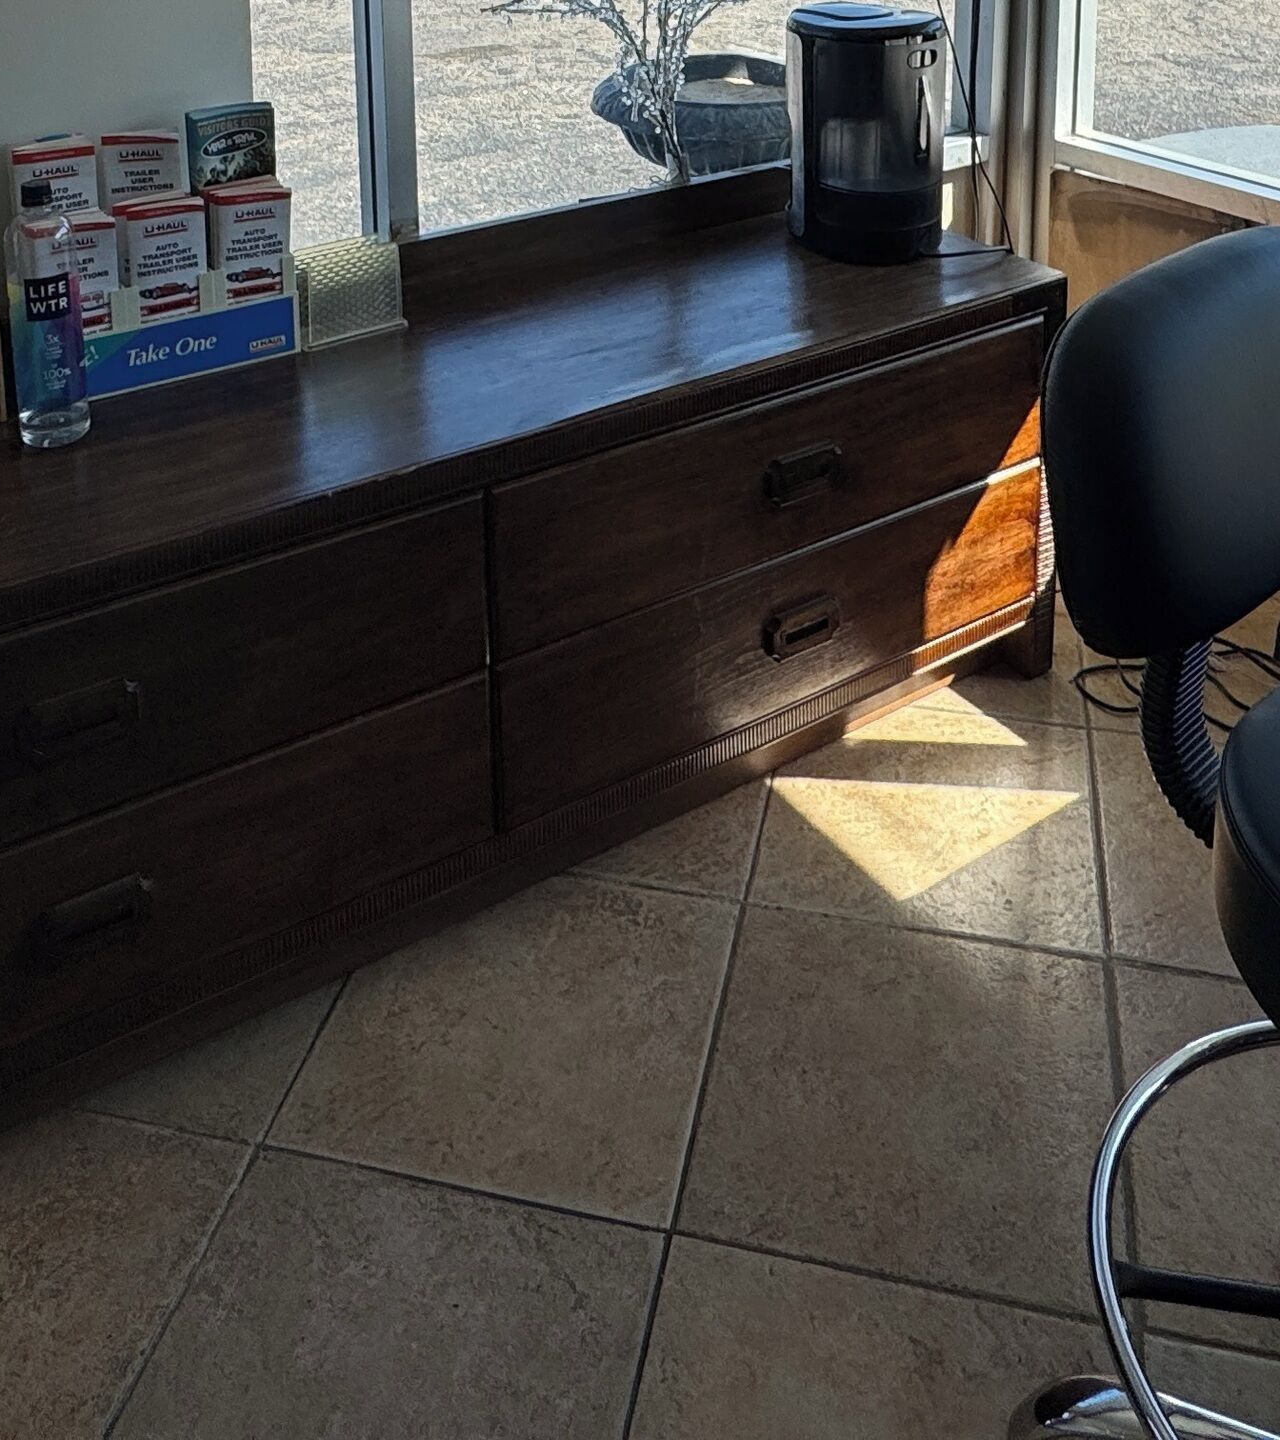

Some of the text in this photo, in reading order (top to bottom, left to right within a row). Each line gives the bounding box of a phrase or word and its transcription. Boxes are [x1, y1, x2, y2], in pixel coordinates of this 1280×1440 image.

[119, 149, 161, 158] U-HAUL
[32, 165, 78, 178] U-HAUL
[124, 169, 160, 177] TRAILER
[131, 177, 154, 185] USER
[111, 183, 174, 194] INSTRUCTIONS
[65, 199, 89, 208] USER
[235, 207, 274, 219] U-HAUL
[145, 220, 186, 234] U-HAUL
[244, 228, 265, 237] AUTO
[231, 233, 278, 246] TRANSPORT
[155, 242, 179, 252] AUTO
[226, 240, 283, 254] TRAILER USER
[142, 247, 192, 261] TRANSPORT
[225, 247, 283, 262] INSTRUCTIONS
[137, 259, 174, 270] TRAILER
[175, 253, 198, 263] USER
[137, 262, 198, 277] INSTRUCTIONS
[29, 281, 67, 299] LIFE
[29, 296, 69, 314] WTR
[127, 335, 217, 368] Take One
